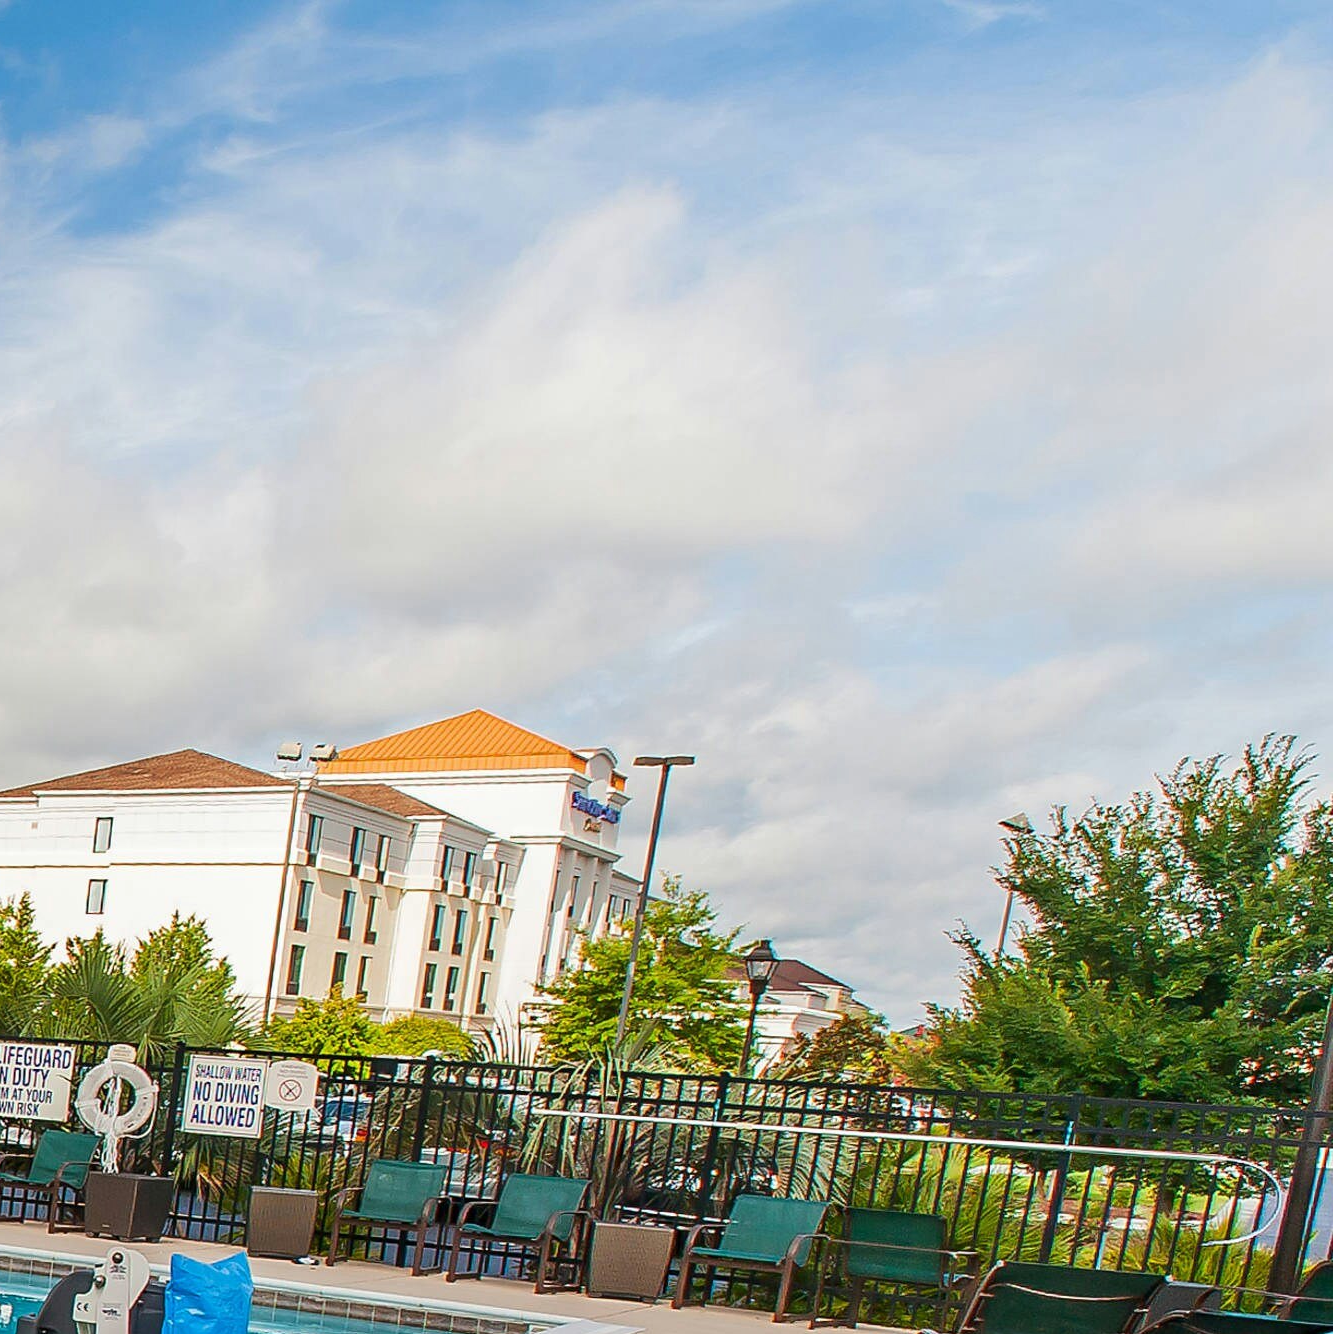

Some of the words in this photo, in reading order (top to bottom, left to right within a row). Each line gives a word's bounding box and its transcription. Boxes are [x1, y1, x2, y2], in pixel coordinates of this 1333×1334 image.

[13, 1068, 50, 1088] DUTY
[195, 1064, 233, 1080] SHALLOW
[235, 1067, 262, 1082] WATER
[11, 1089, 23, 1100] AT
[26, 1090, 53, 1103] YOUR
[193, 1081, 211, 1101] NO
[215, 1083, 259, 1105] DIVING
[17, 1103, 40, 1116] RISK
[190, 1104, 255, 1128] ALLOWED
